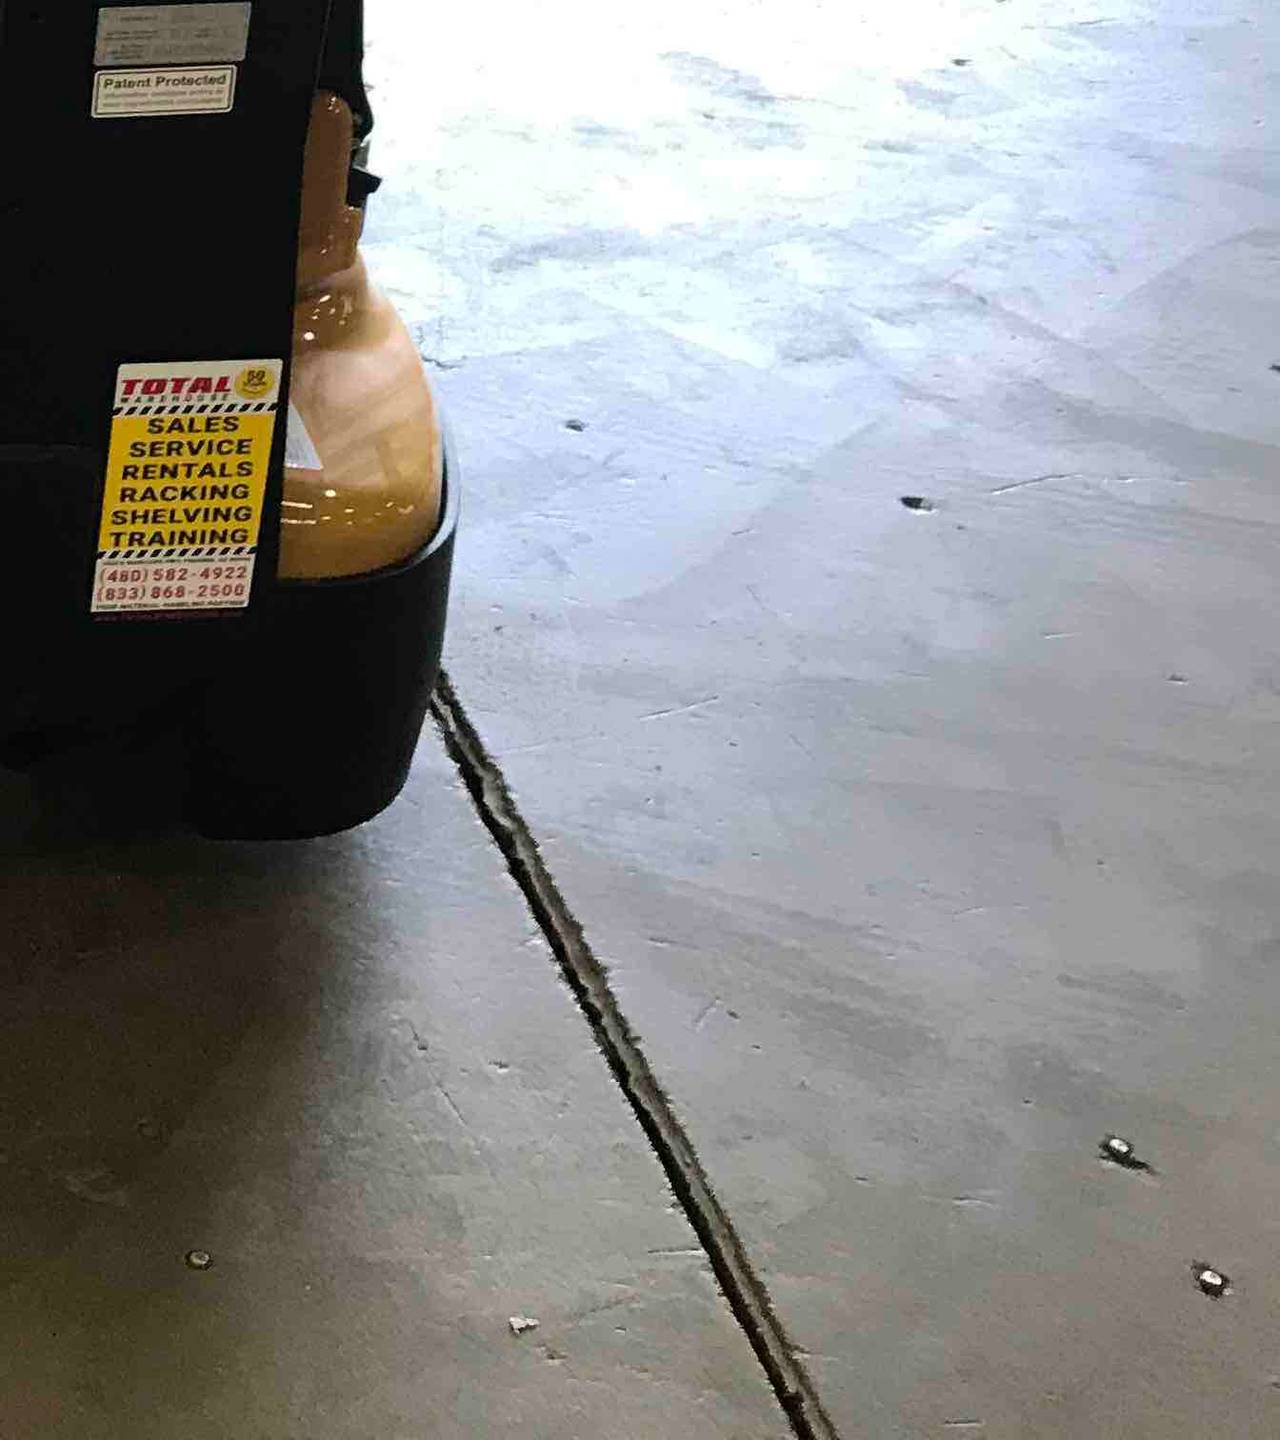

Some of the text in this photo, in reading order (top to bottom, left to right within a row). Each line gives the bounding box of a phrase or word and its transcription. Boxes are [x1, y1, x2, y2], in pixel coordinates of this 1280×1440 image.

[103, 74, 227, 89] Patent Protected
[121, 376, 231, 396] TOTAL
[147, 416, 239, 434] SALES
[129, 438, 253, 458] SERVICE
[121, 461, 253, 481] RENTALS
[119, 484, 249, 503] RACKING
[110, 506, 252, 526] SHELVING
[110, 528, 249, 548] TRAINING
[100, 566, 247, 585] (480) 582-4922
[96, 585, 146, 602] (833)
